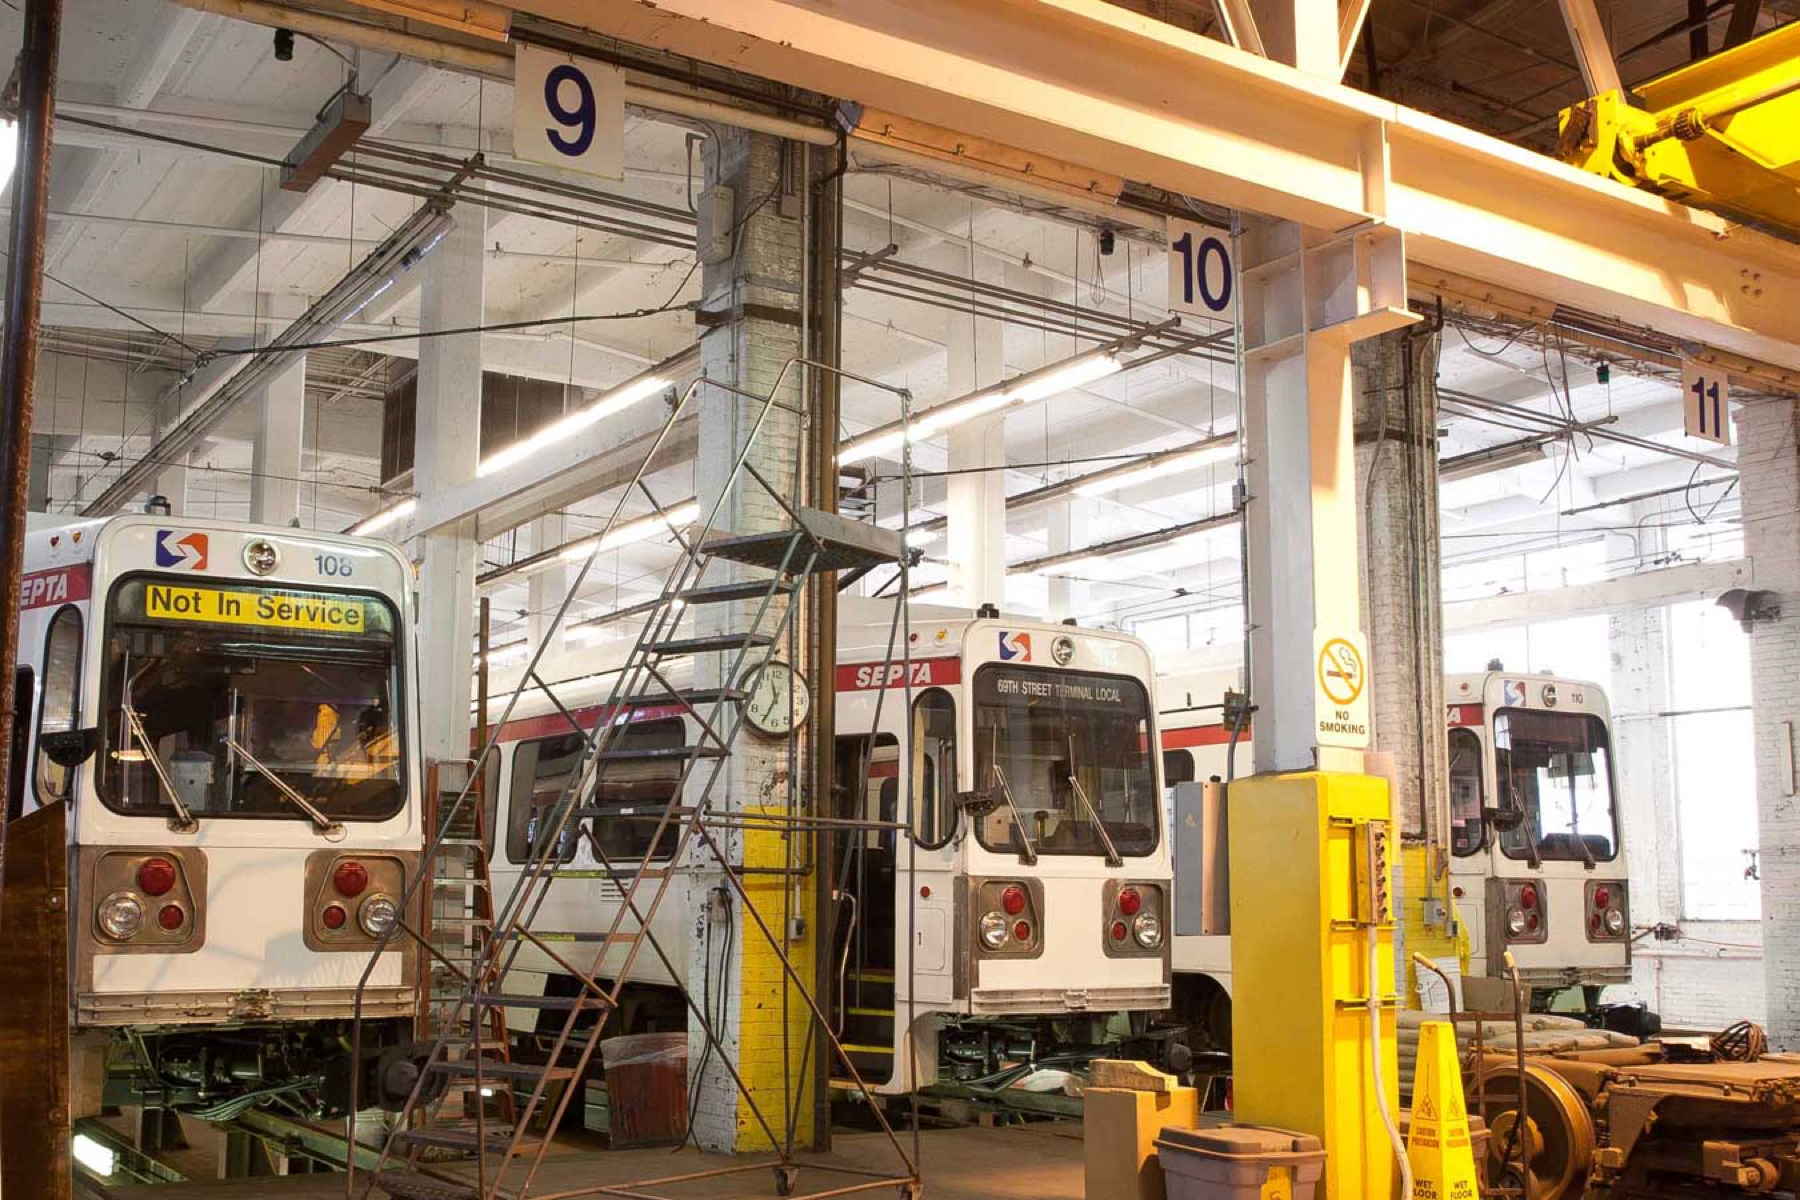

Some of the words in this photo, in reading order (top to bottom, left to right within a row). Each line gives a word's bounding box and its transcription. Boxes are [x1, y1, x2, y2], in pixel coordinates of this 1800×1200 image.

[544, 64, 596, 157] 9
[1173, 232, 1232, 311] 10
[1691, 376, 1720, 438] 11
[314, 554, 353, 577] 108
[20, 574, 69, 606] EPTA
[151, 586, 202, 614] Not
[218, 592, 241, 617] In
[256, 595, 360, 626] Service
[855, 663, 932, 688] SEPTA
[997, 679, 1018, 694] 69TH
[1021, 681, 1053, 697] STREET
[1095, 687, 1121, 702] LOCAL
[1319, 721, 1366, 735] SMOKING
[1335, 711, 1350, 721] NO
[1413, 1188, 1437, 1199] LOOR
[1415, 1178, 1433, 1189] WET
